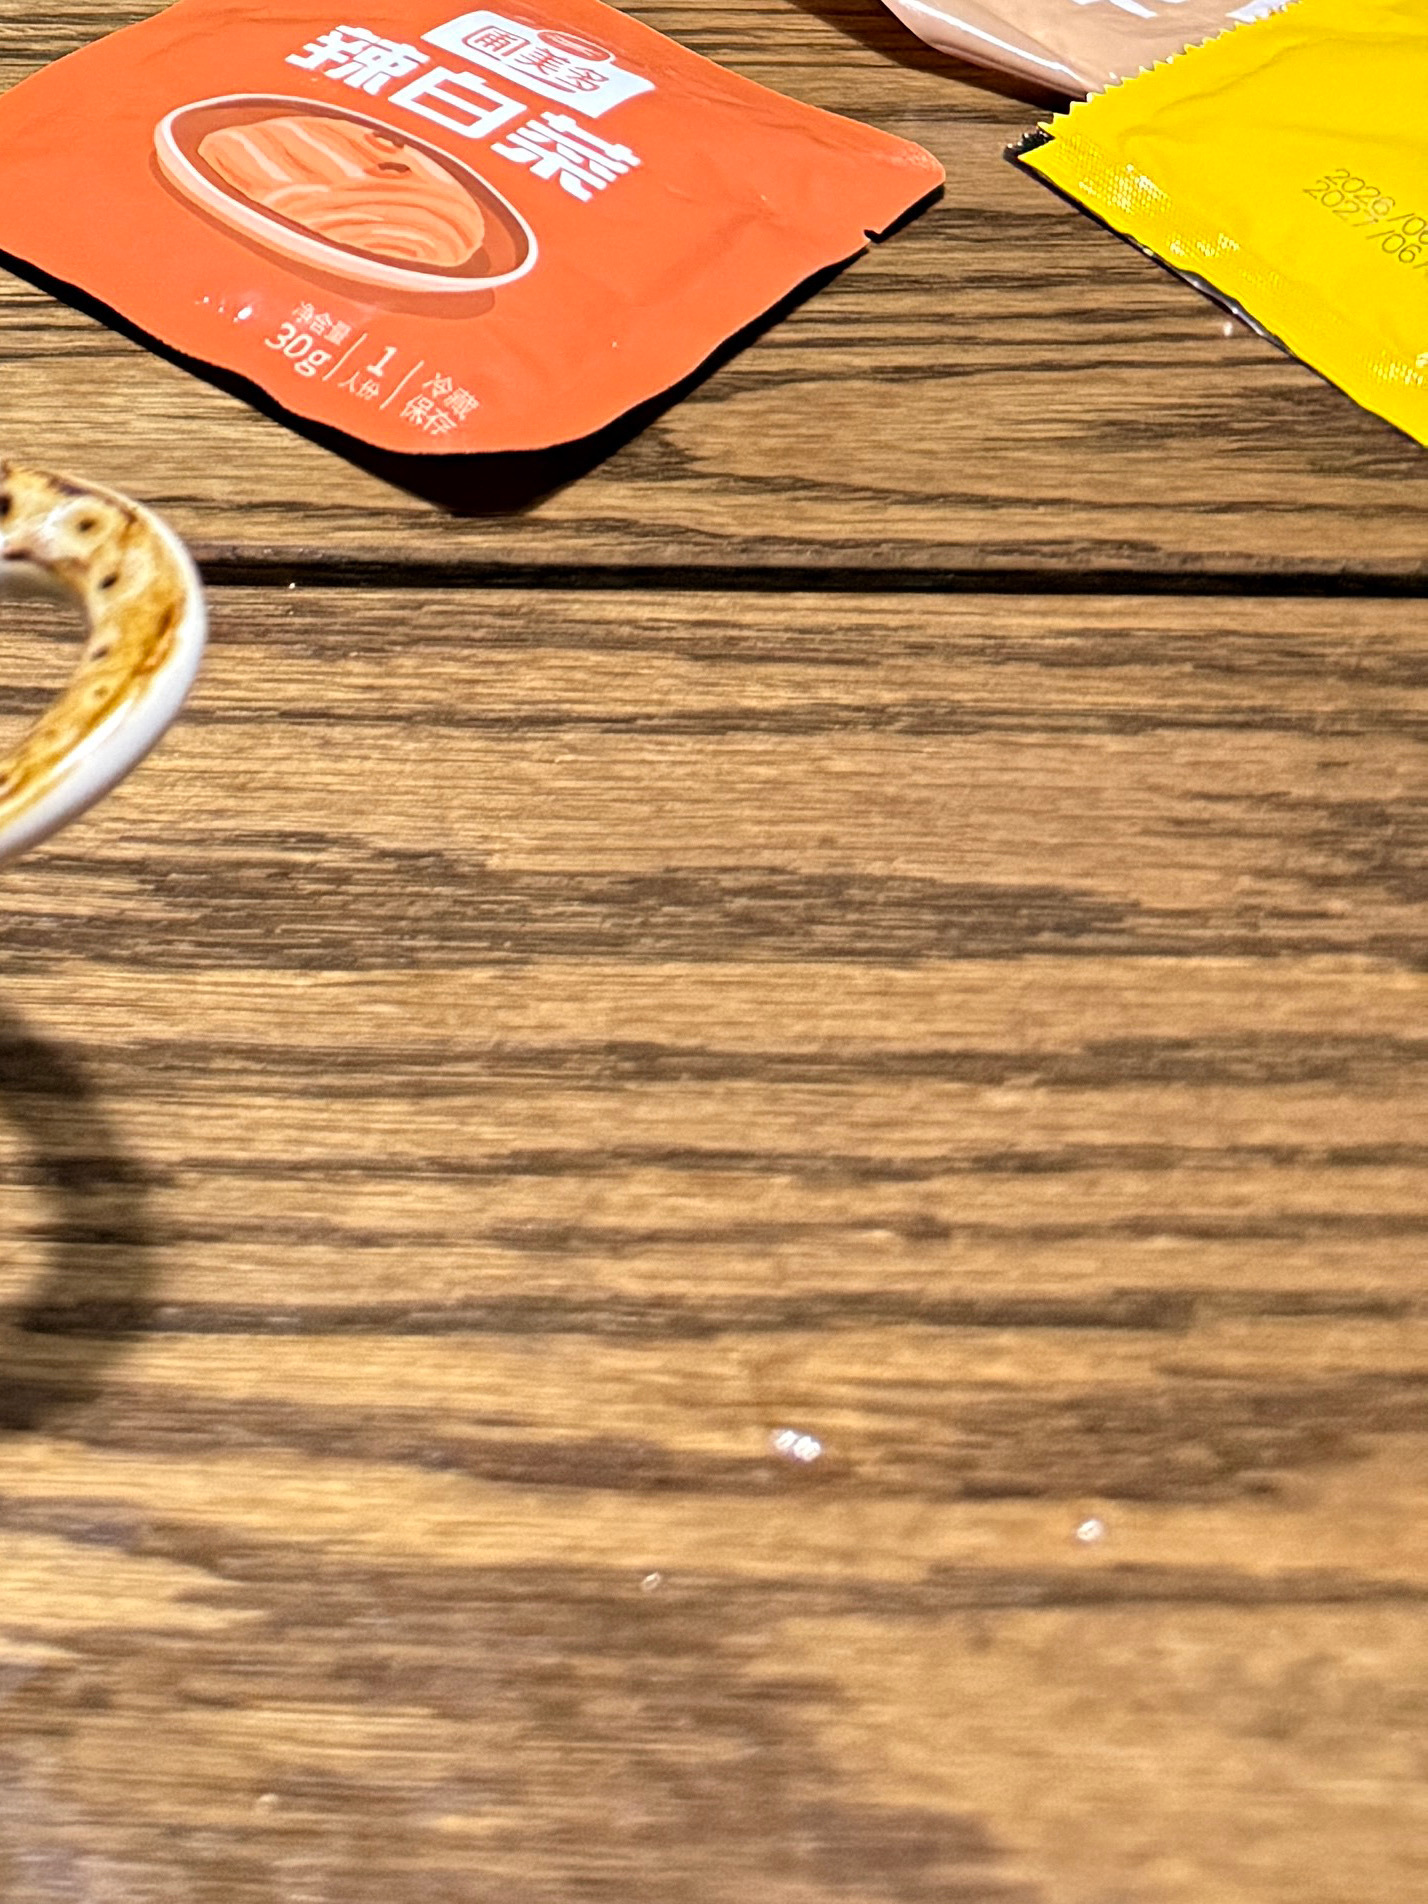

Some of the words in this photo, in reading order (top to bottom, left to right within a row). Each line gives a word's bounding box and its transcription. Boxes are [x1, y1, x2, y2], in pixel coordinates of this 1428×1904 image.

[461, 25, 609, 93] 圃美多
[285, 24, 642, 203] 辣白菜
[292, 301, 352, 346] 净含量
[264, 322, 332, 378] 30g
[366, 345, 398, 377] 1
[337, 370, 380, 401] 人份
[422, 372, 480, 421] 冷藏
[399, 394, 458, 436] 保存
